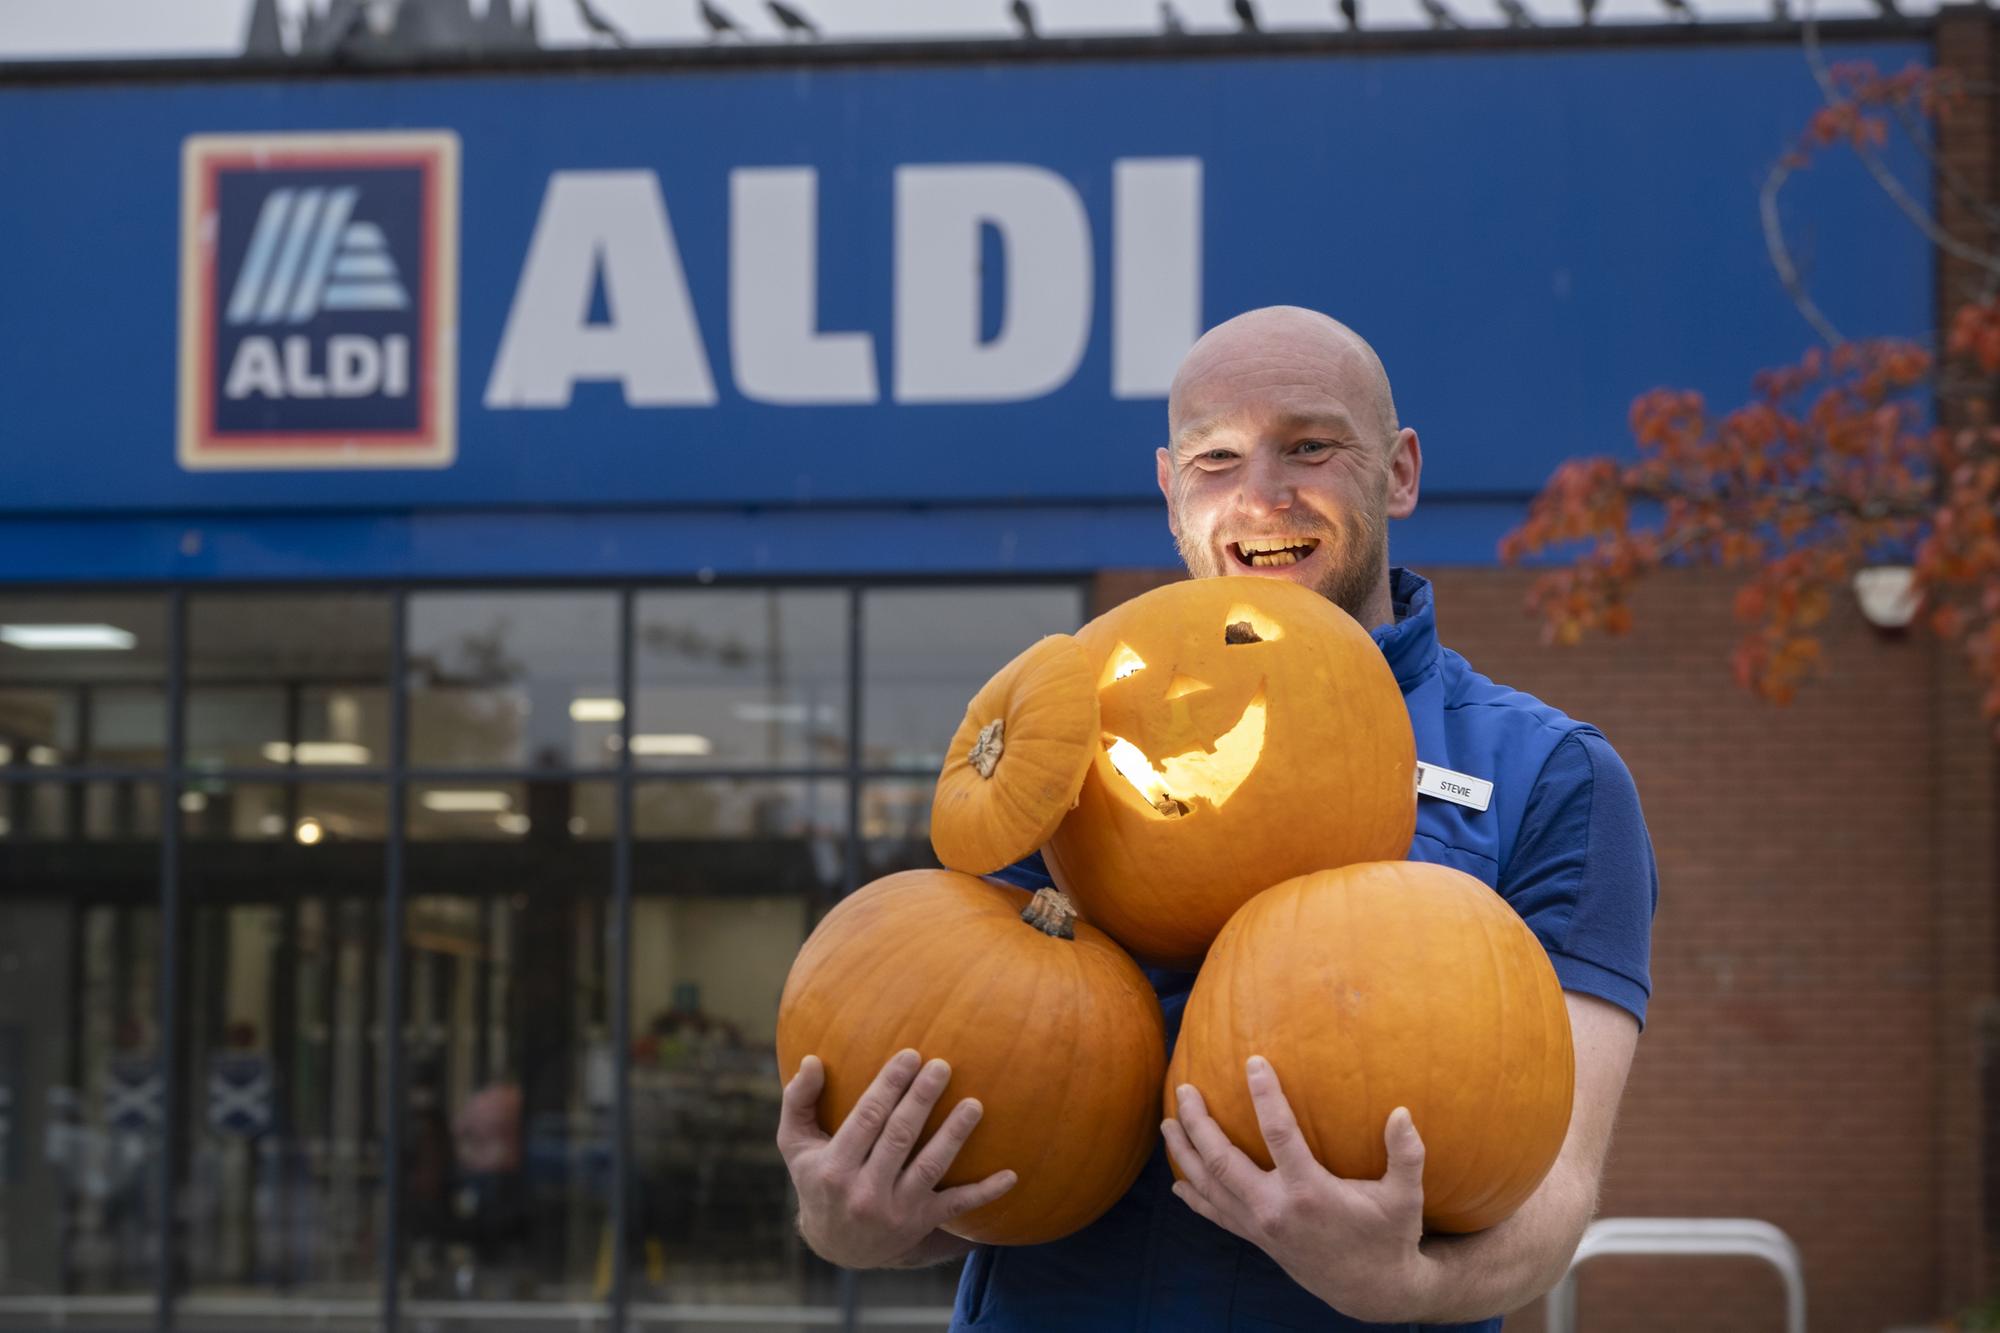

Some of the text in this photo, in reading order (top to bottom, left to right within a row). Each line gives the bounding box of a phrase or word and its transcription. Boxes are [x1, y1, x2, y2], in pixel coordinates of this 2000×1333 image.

[484, 157, 1203, 409] ALDI
[225, 334, 409, 398] ALDI
[1440, 781, 1471, 797] STEVIE
